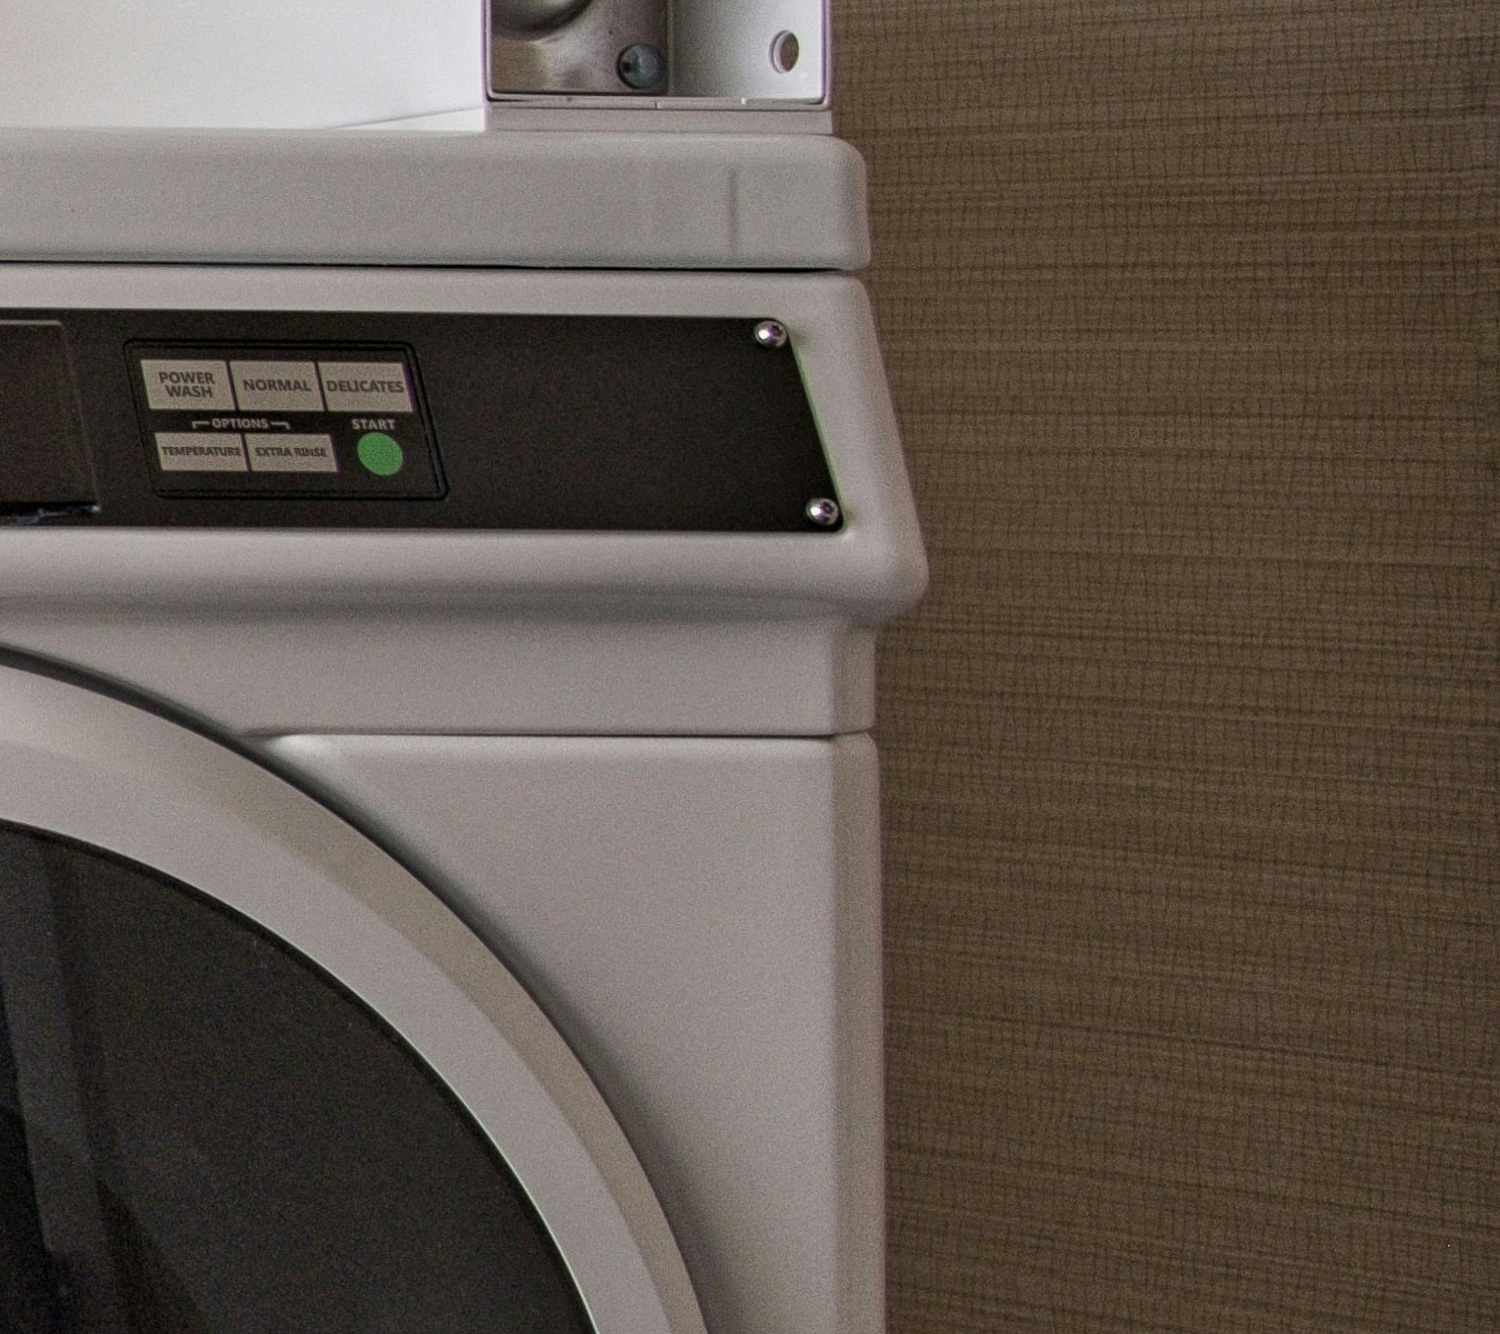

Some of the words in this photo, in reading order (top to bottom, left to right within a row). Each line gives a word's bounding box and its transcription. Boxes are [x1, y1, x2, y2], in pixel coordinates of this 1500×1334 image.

[158, 371, 216, 385] POWER
[164, 385, 213, 399] WASH
[242, 378, 312, 393] NORMAL
[326, 379, 405, 394] DELICATES
[211, 417, 270, 430] OPTIONS
[351, 418, 397, 431] START
[255, 446, 292, 457] EXTRA
